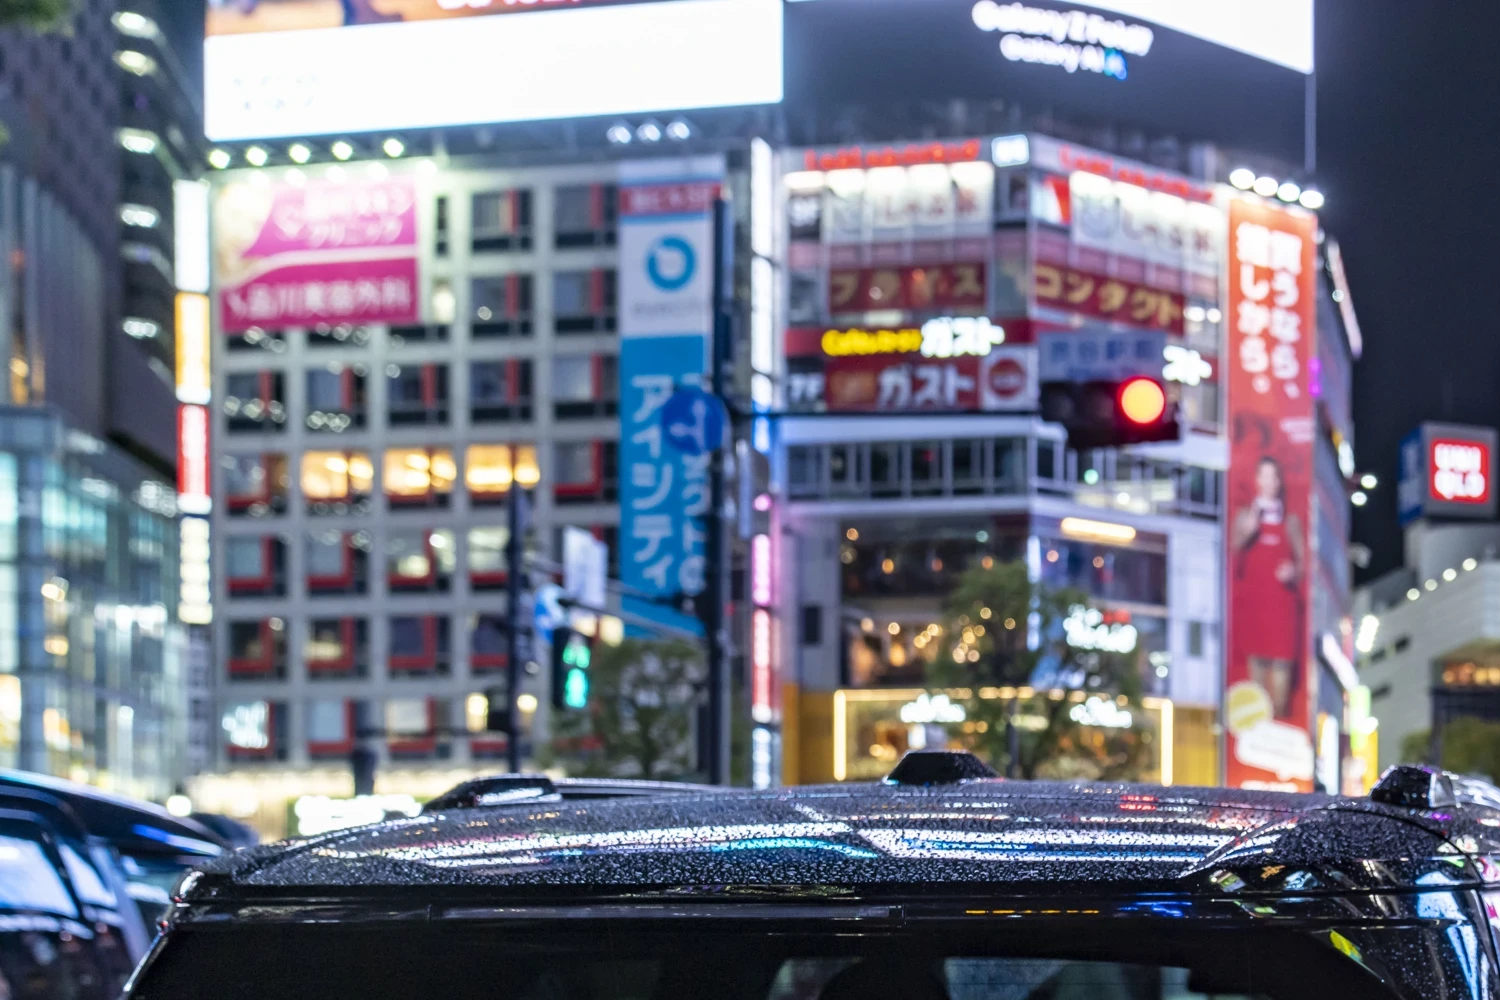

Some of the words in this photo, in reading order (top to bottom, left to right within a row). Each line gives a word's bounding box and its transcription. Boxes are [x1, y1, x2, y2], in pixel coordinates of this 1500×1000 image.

[1162, 345, 1212, 386] スト
[632, 374, 673, 589] アイシティ
